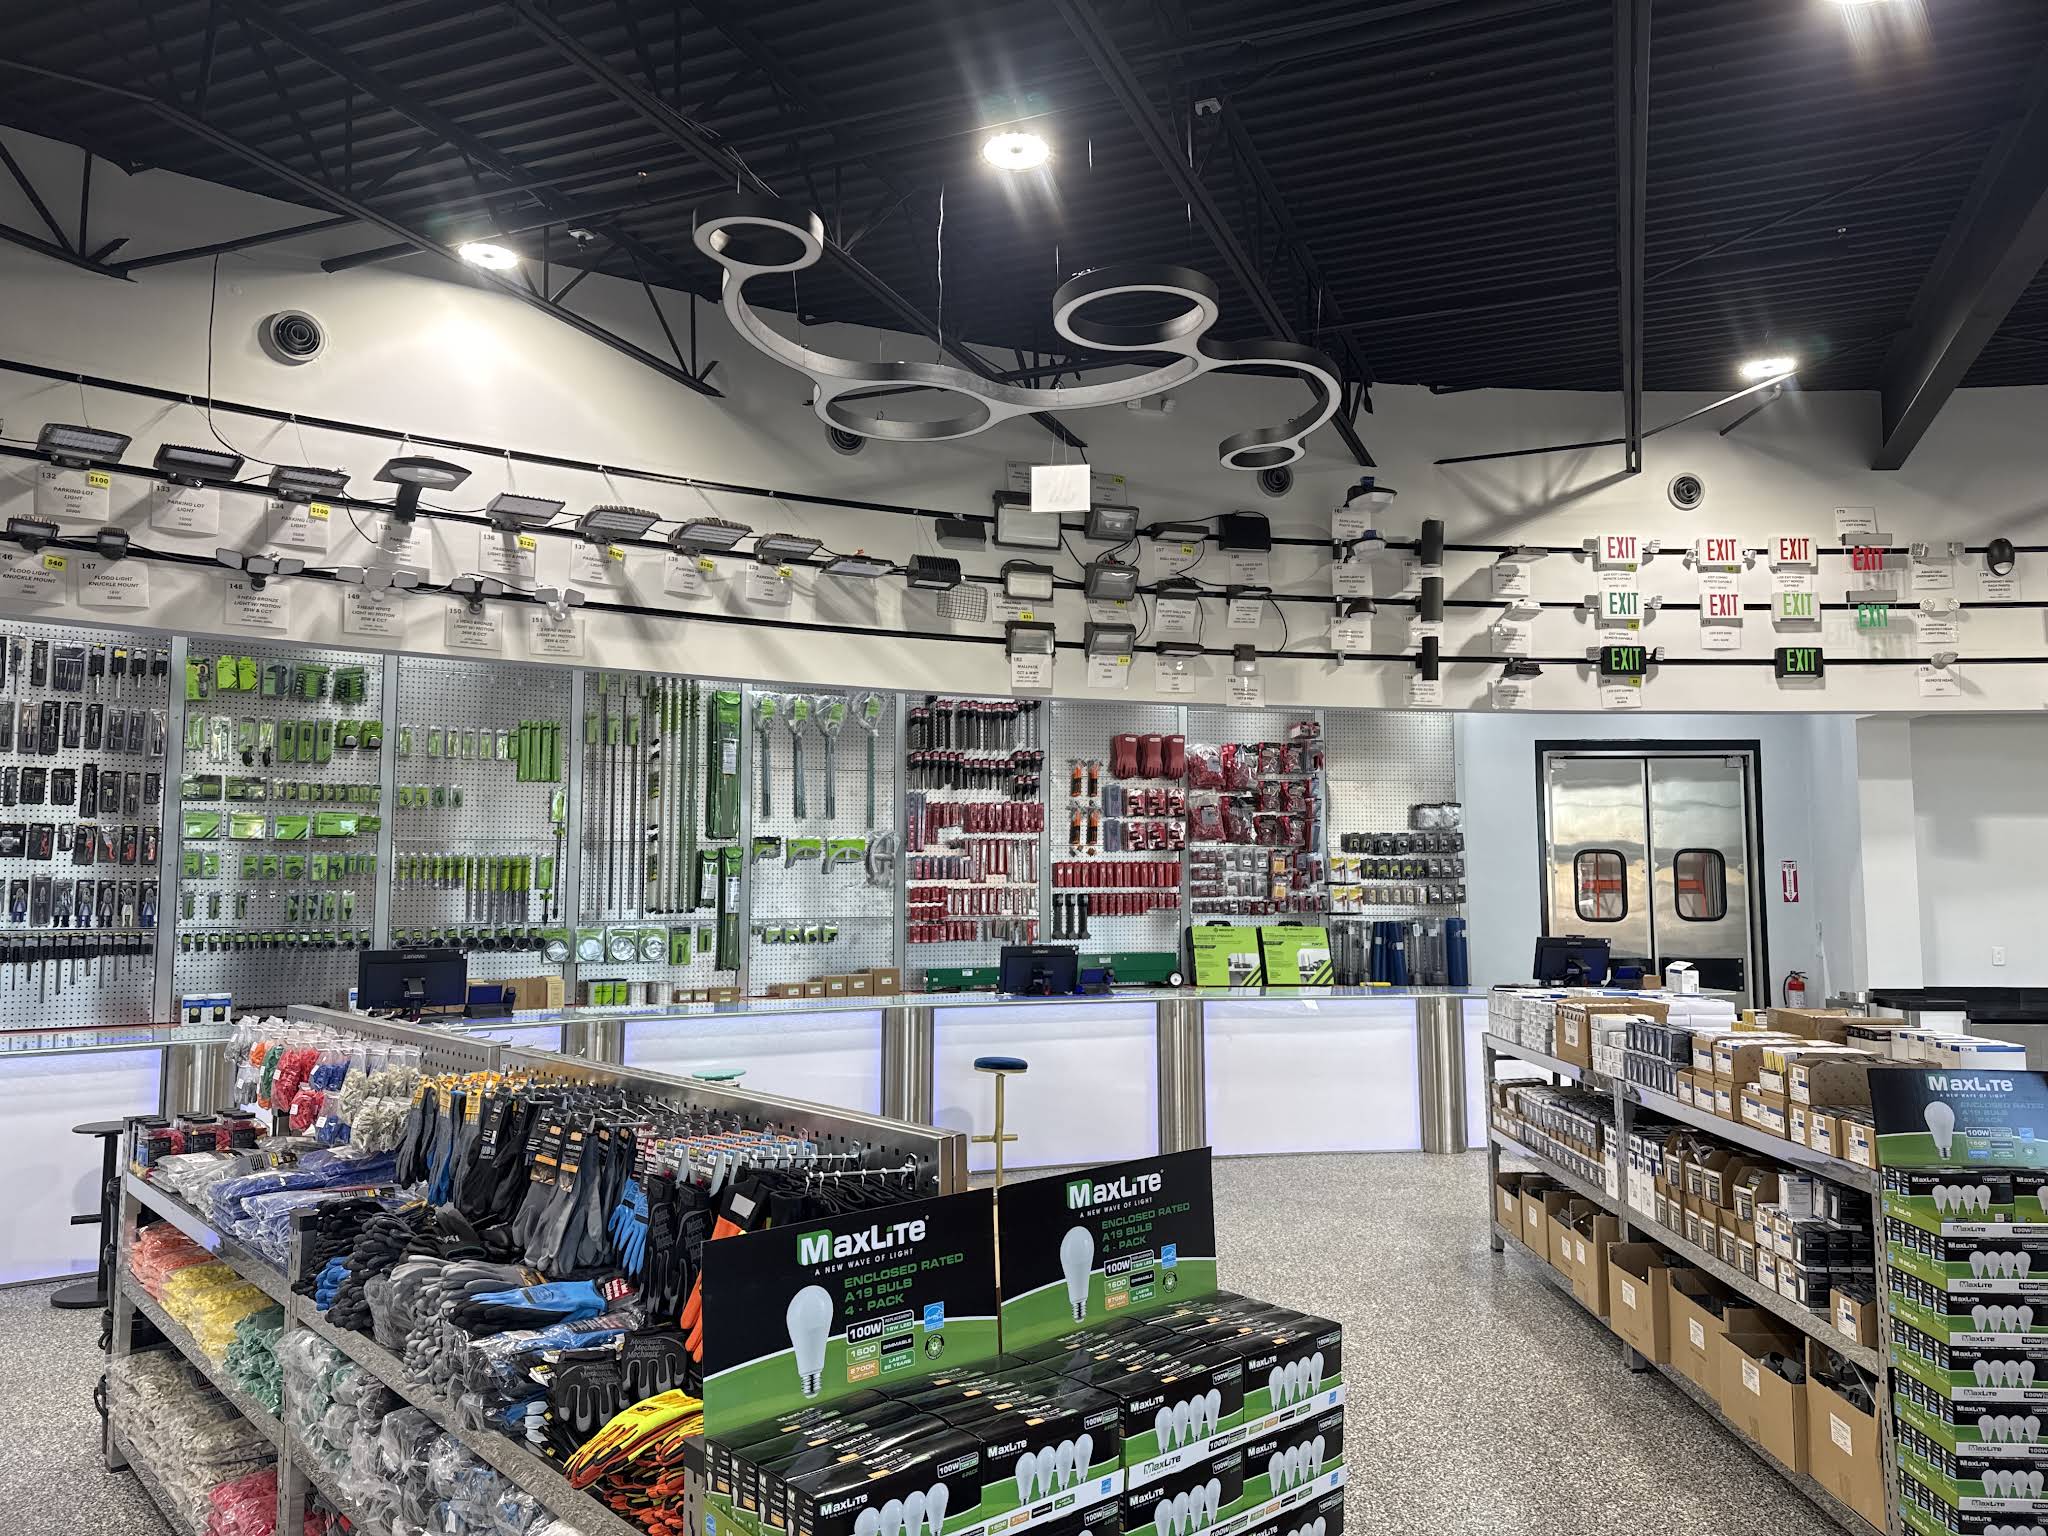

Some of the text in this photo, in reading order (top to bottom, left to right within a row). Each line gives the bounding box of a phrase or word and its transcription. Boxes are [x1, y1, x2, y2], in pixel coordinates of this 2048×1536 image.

[41, 472, 56, 480] 132
[90, 476, 109, 485] $100
[53, 486, 81, 495] PARKING
[167, 499, 192, 508] PARKING
[311, 506, 329, 515] $100
[281, 515, 304, 523] PARKING
[1607, 537, 1636, 559] EXIT
[1707, 539, 1736, 561] EXIT
[1780, 538, 1809, 560] EXIT
[48, 559, 62, 567] $40
[1853, 547, 1884, 571] EXIT
[1609, 593, 1638, 615] EXIT
[1710, 594, 1739, 616] EXIT
[1783, 593, 1813, 616] EXIT
[1857, 604, 1889, 628] EXIT
[1611, 648, 1641, 670] EXIT
[1786, 649, 1817, 672] EXIT
[1967, 1129, 1990, 1137] 100W
[1087, 1208, 1101, 1217] NEW
[1104, 1203, 1121, 1213] WAVE
[1123, 1201, 1132, 1209] OF
[1134, 1197, 1153, 1207] LIGHT
[1102, 1203, 1190, 1230] ENCLOSED RATED
[1102, 1223, 1153, 1242] A19 BULB
[1103, 1245, 1110, 1254] 4
[1119, 1236, 1147, 1250] PACK
[825, 1263, 844, 1274] NEW
[848, 1258, 871, 1268] WAVE
[875, 1254, 886, 1263] OF
[889, 1248, 914, 1260] LIGHT
[1106, 1259, 1131, 1274] 100W
[844, 1253, 964, 1289] ENCLOSED RATED
[845, 1278, 913, 1303] A19 BULB
[845, 1306, 855, 1316] 4
[867, 1294, 905, 1312] PACK
[850, 1321, 881, 1339] 100W
[882, 1338, 912, 1350] DIMMABLE
[888, 1354, 907, 1363] LASTS
[892, 1359, 912, 1368] YEARS
[1213, 1373, 1229, 1384] 100W
[1086, 1416, 1103, 1427] 100W
[1210, 1437, 1229, 1451] 100W
[939, 1461, 960, 1475] 100W
[1086, 1511, 1103, 1524] 100W
